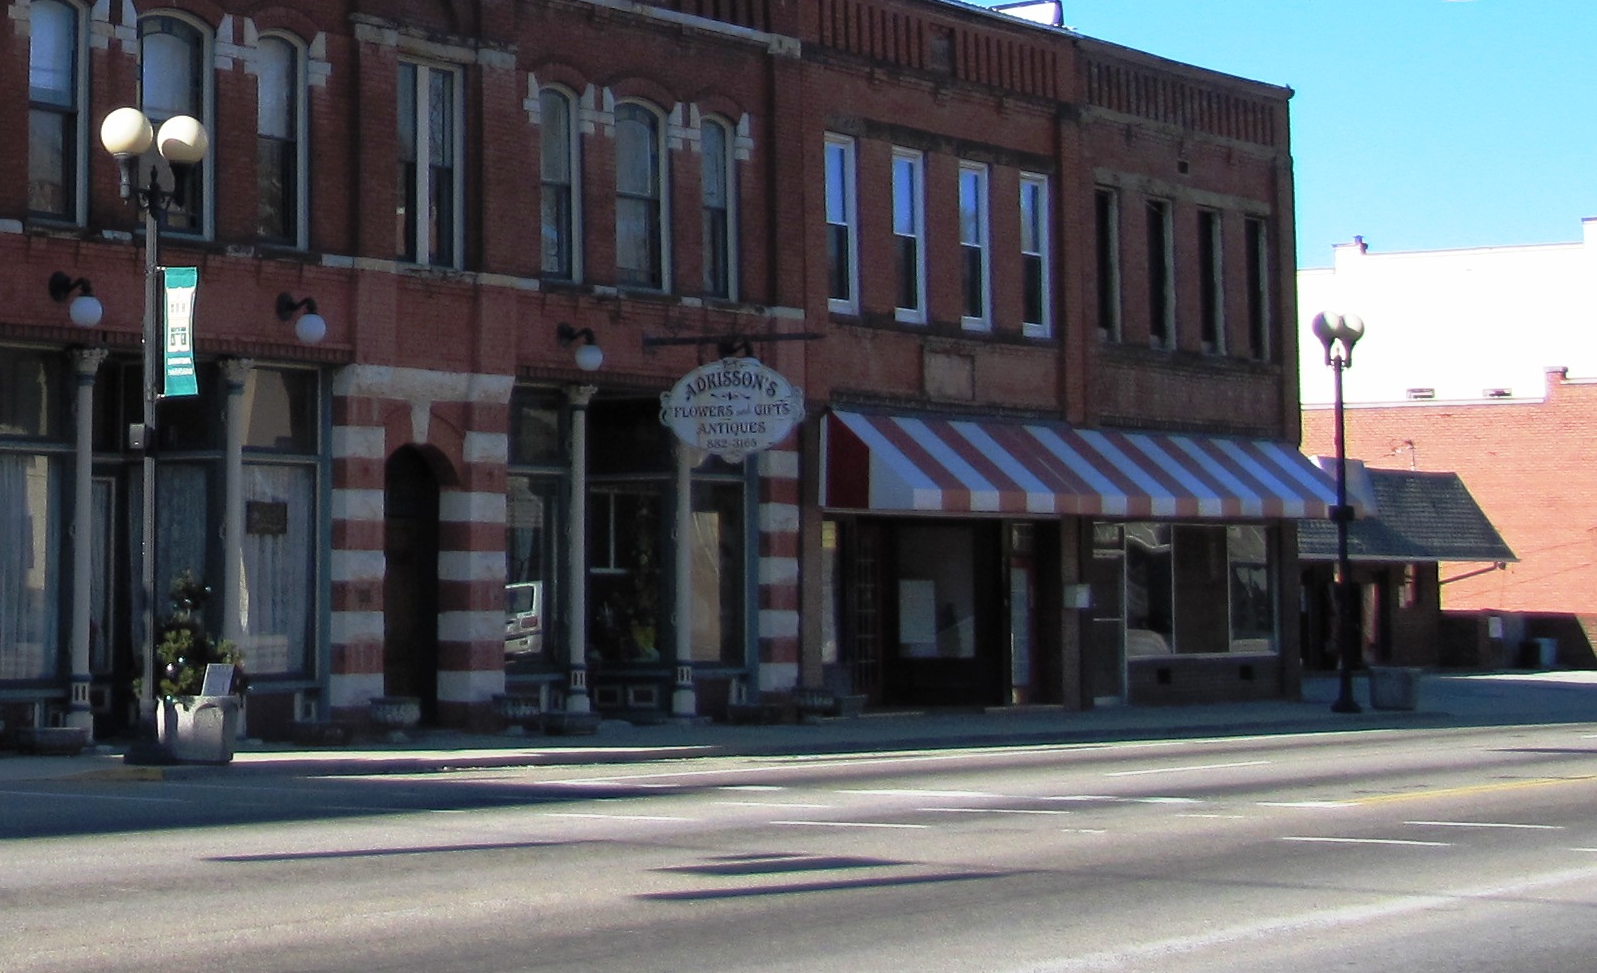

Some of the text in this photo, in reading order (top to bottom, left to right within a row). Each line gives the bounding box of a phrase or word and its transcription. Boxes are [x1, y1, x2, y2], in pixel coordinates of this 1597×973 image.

[674, 405, 733, 418] FLOWERS
[754, 403, 789, 416] GIFTS
[698, 422, 765, 435] ANTIQUES
